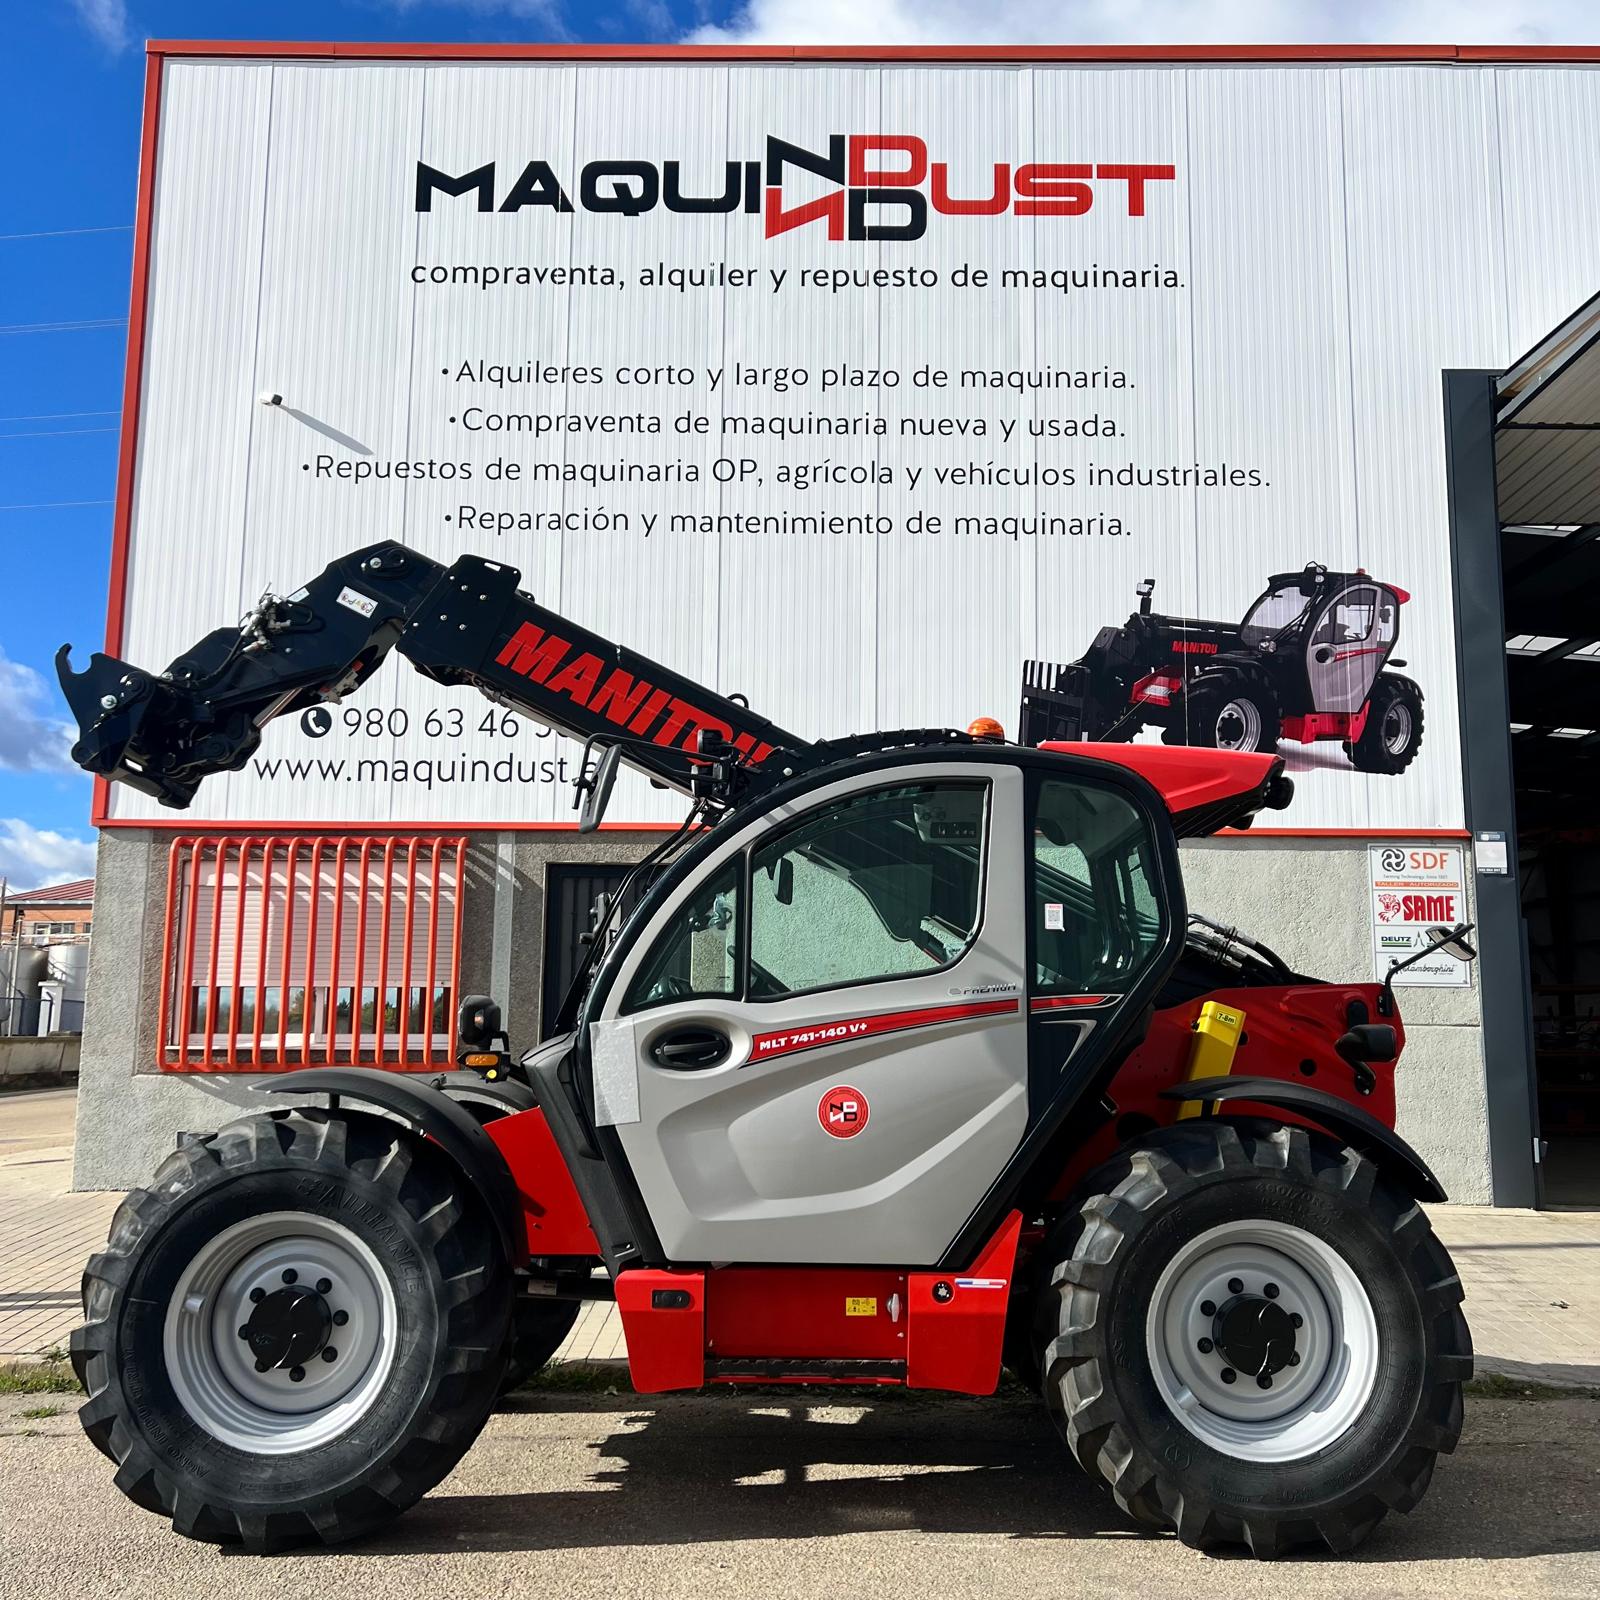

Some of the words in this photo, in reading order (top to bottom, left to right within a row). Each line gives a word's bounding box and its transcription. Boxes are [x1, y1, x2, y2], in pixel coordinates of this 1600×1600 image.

[411, 264, 625, 291] compraventa,
[639, 262, 758, 293] alquiler
[769, 269, 787, 294] y
[801, 266, 938, 294] repuesto
[950, 263, 988, 288] de
[1002, 263, 1185, 295] maquinaria.
[455, 359, 603, 389] Alquileres
[616, 365, 695, 386] corto
[706, 368, 724, 392] y
[736, 362, 809, 393] largo
[821, 363, 900, 393] plazo
[912, 364, 948, 388] de
[961, 365, 1136, 395] maquinaria.
[462, 407, 661, 438] Compraventa
[674, 410, 710, 434] de
[722, 411, 887, 441] maquinaria
[900, 418, 987, 436] nueva
[999, 419, 1017, 443] y
[1029, 413, 1125, 437] usada.
[316, 455, 472, 485] Repuestos
[485, 457, 521, 481] de
[533, 458, 699, 488] maquinaria
[712, 458, 763, 488] OP,
[776, 458, 893, 490] agrícola
[905, 467, 923, 491] y
[934, 460, 1076, 486] vehículos
[1089, 462, 1270, 487] industriales.
[458, 505, 629, 536] Reparación
[641, 513, 658, 538] y
[670, 510, 893, 535] mantenimiento
[905, 510, 942, 535] de
[955, 511, 1131, 541] maquinaria.
[1172, 640, 1217, 655] MANITOU
[343, 707, 409, 737] 980
[424, 708, 464, 738] 63
[477, 708, 520, 738] 46
[1410, 852, 1449, 870] SDF
[1402, 895, 1454, 922] SAME
[760, 1038, 788, 1051] MLT
[790, 1026, 847, 1045] 741-140
[849, 1022, 868, 1033] V+
